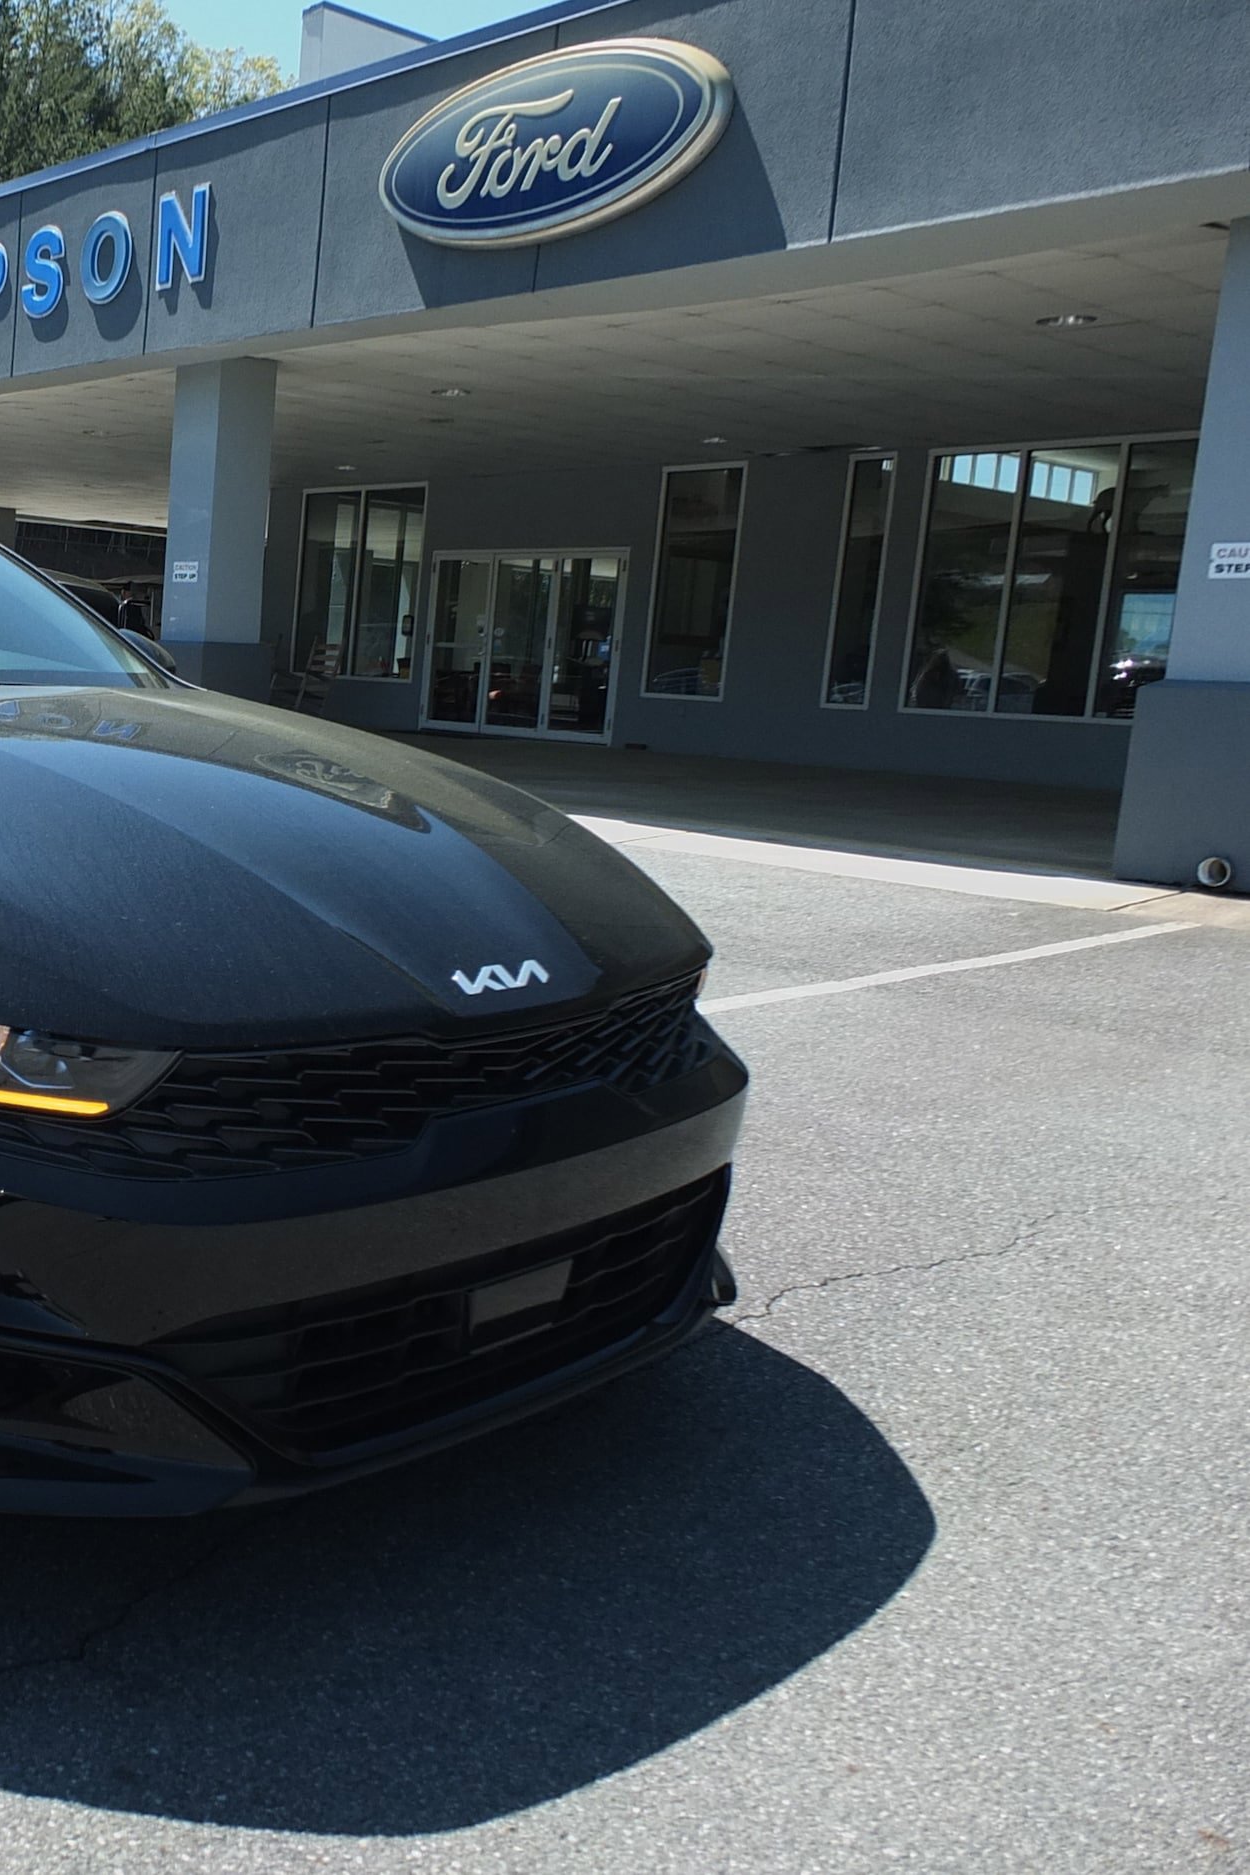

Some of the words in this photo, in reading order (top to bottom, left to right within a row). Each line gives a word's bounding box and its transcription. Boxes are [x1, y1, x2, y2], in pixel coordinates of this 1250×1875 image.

[436, 89, 623, 210] Ford
[1216, 548, 1250, 559] CAU
[451, 959, 550, 996] KIA
